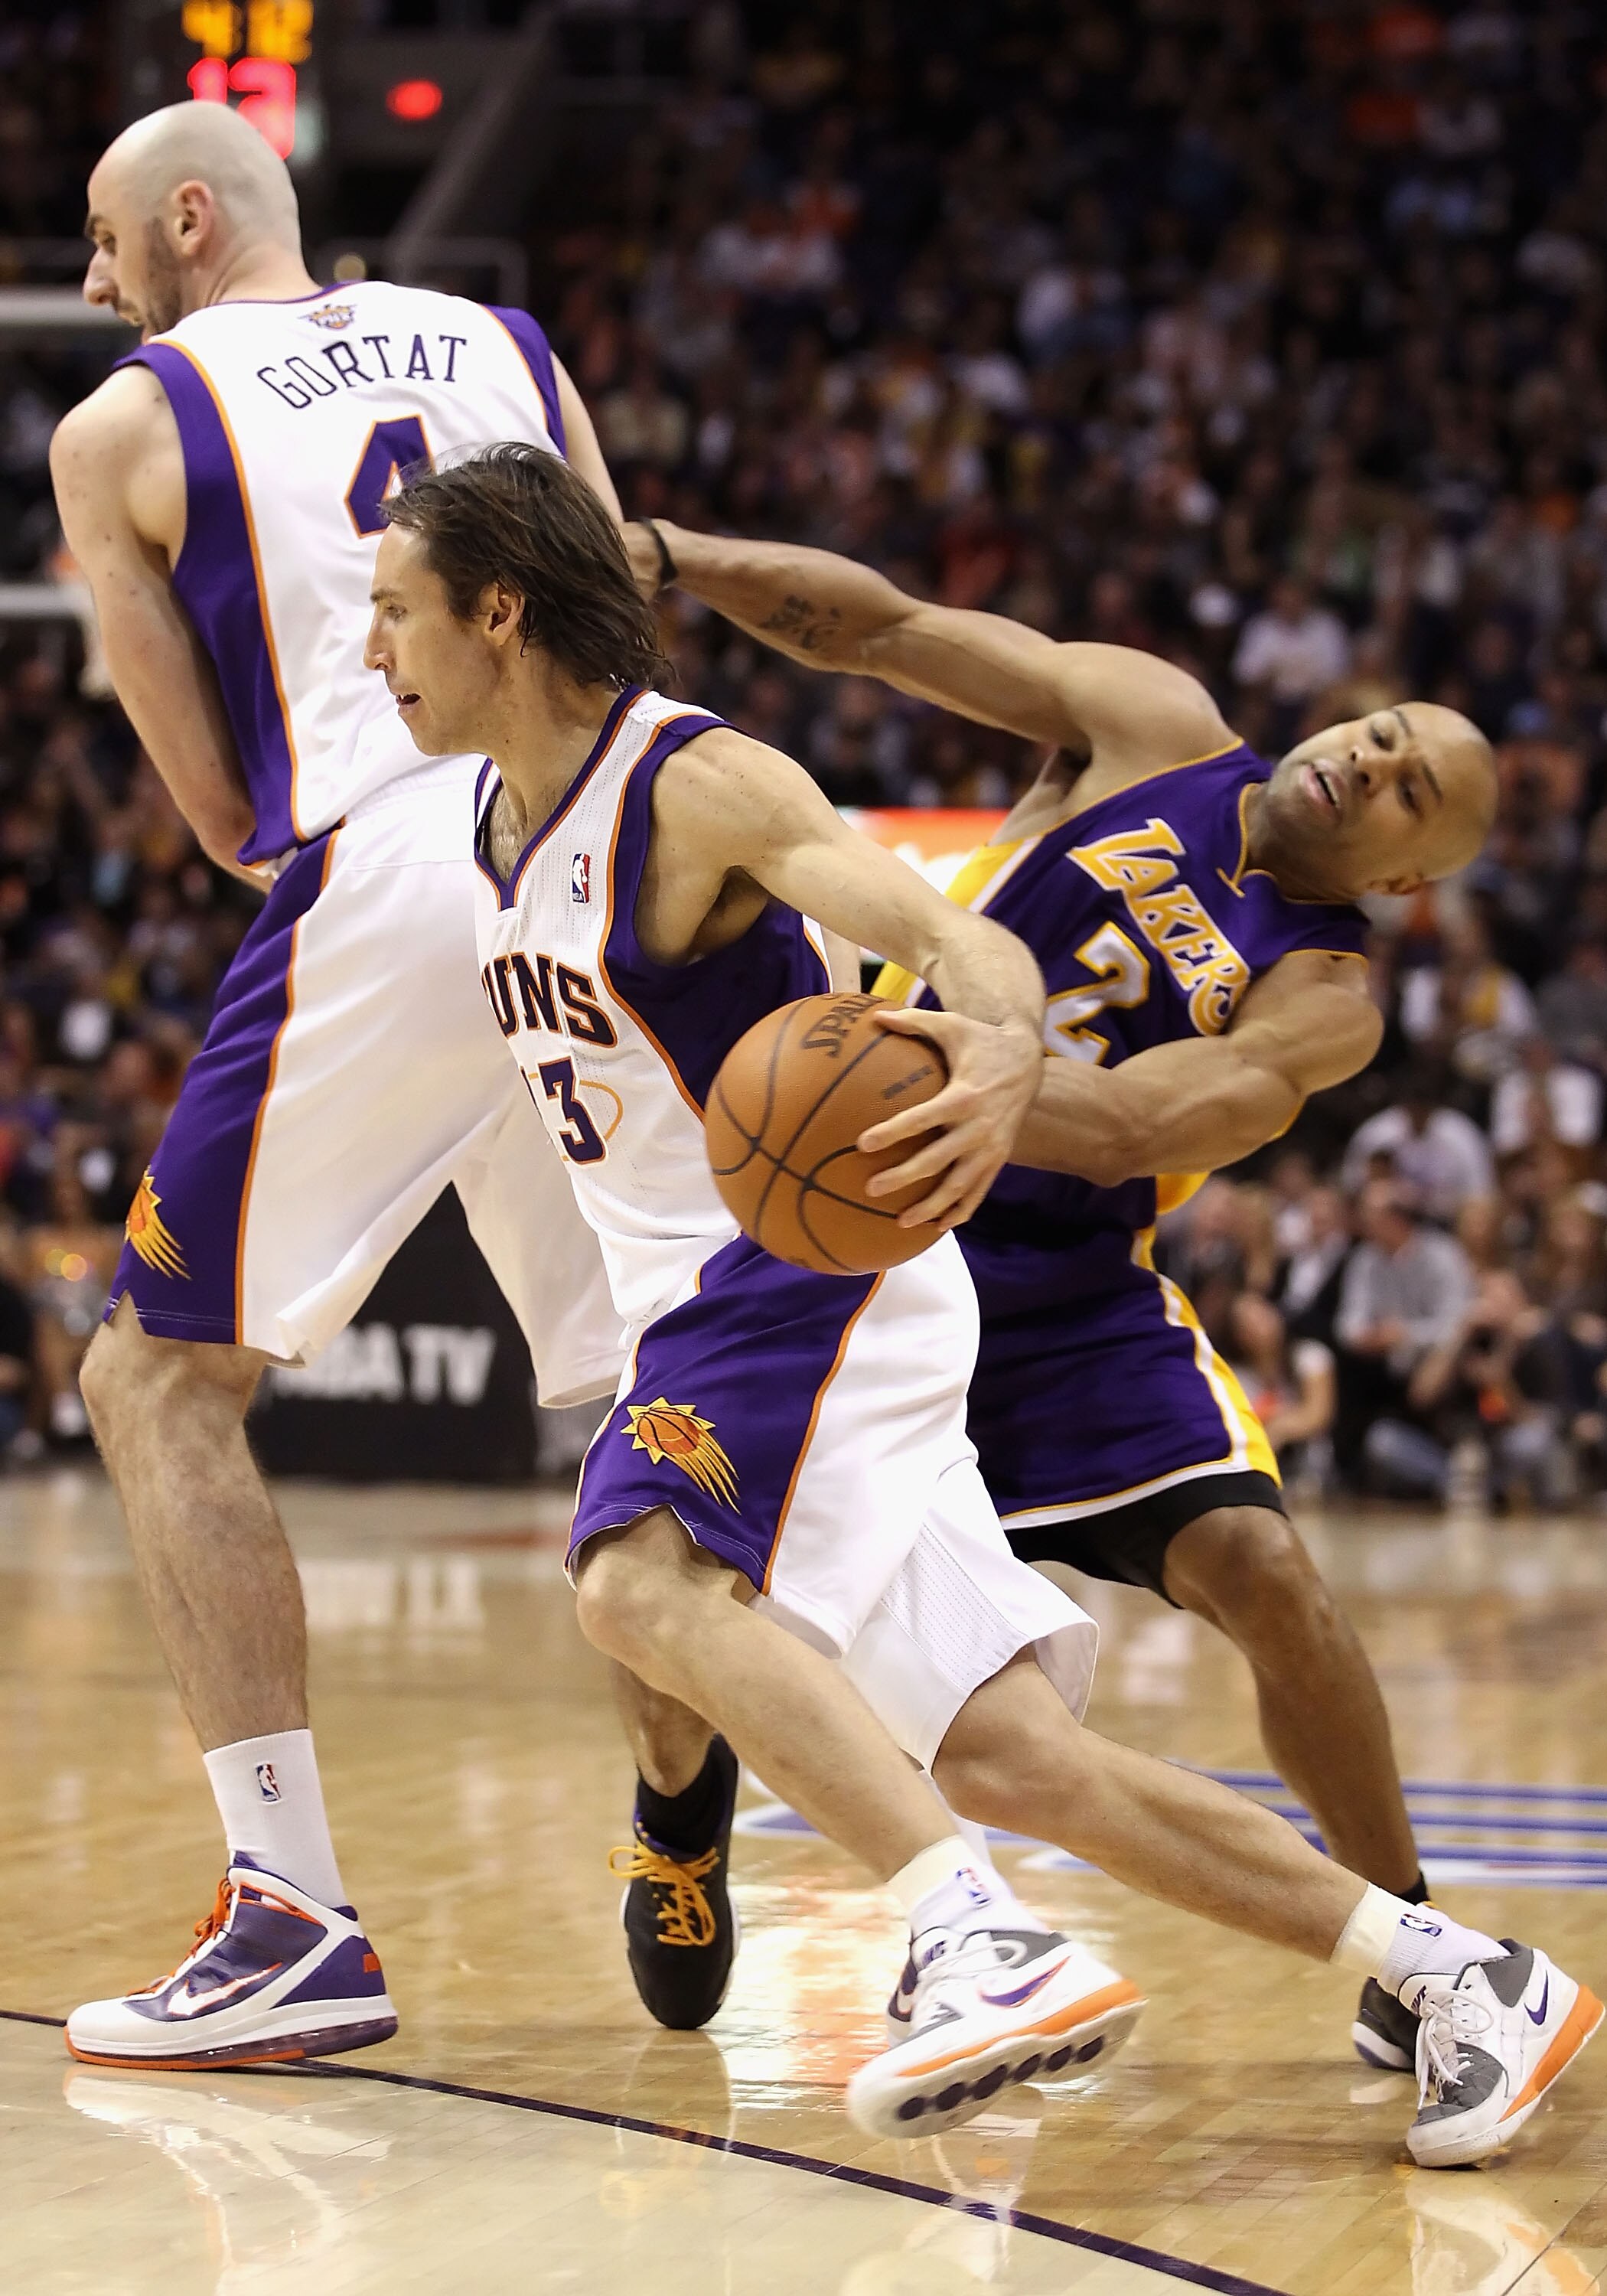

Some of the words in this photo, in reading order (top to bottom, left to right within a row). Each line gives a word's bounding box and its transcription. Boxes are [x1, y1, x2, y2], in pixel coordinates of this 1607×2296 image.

[256, 334, 468, 409] GORTAT
[344, 413, 436, 539] 4
[1066, 817, 1250, 1036] LAKERS
[481, 951, 618, 1049] UNS
[1043, 921, 1151, 1065] 2
[520, 1056, 606, 1165] 3
[403, 1323, 496, 1407] TV
